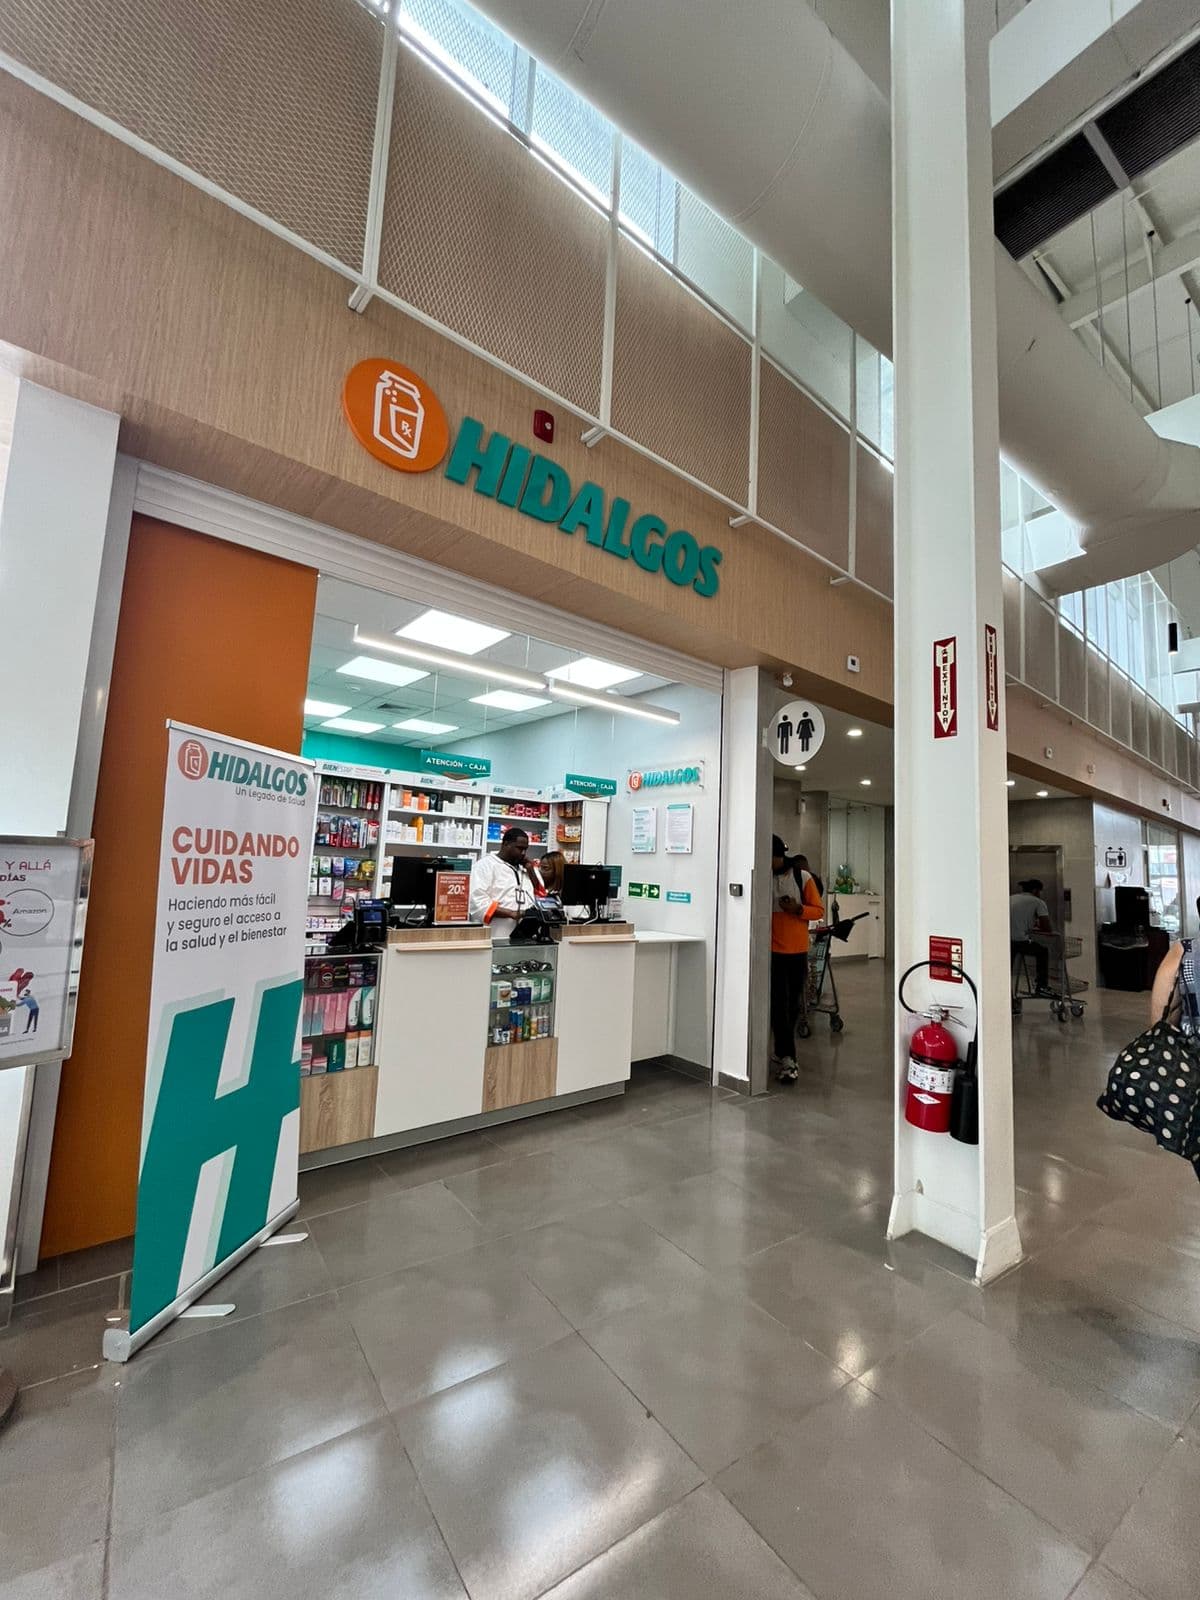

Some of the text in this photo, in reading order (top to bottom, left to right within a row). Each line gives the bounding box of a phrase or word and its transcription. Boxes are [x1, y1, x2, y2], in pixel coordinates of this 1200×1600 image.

[444, 416, 723, 598] HIDALGOS
[941, 665, 949, 724] EXTINTOR
[207, 751, 308, 797] HIDALGOS
[426, 757, 463, 768] ATENCIÓN
[469, 763, 487, 772] CAJA
[642, 766, 700, 788] HIDALGOS
[235, 786, 306, 807] Un Legado de Salud
[172, 826, 300, 858] CUIDANDO
[5, 859, 51, 870] Y ALLÁ
[170, 857, 254, 885] VIDAS
[168, 893, 276, 911] Haciendo más fácil
[167, 912, 281, 936] y seguro el acceso a
[165, 926, 287, 952] la salud y el bienestar
